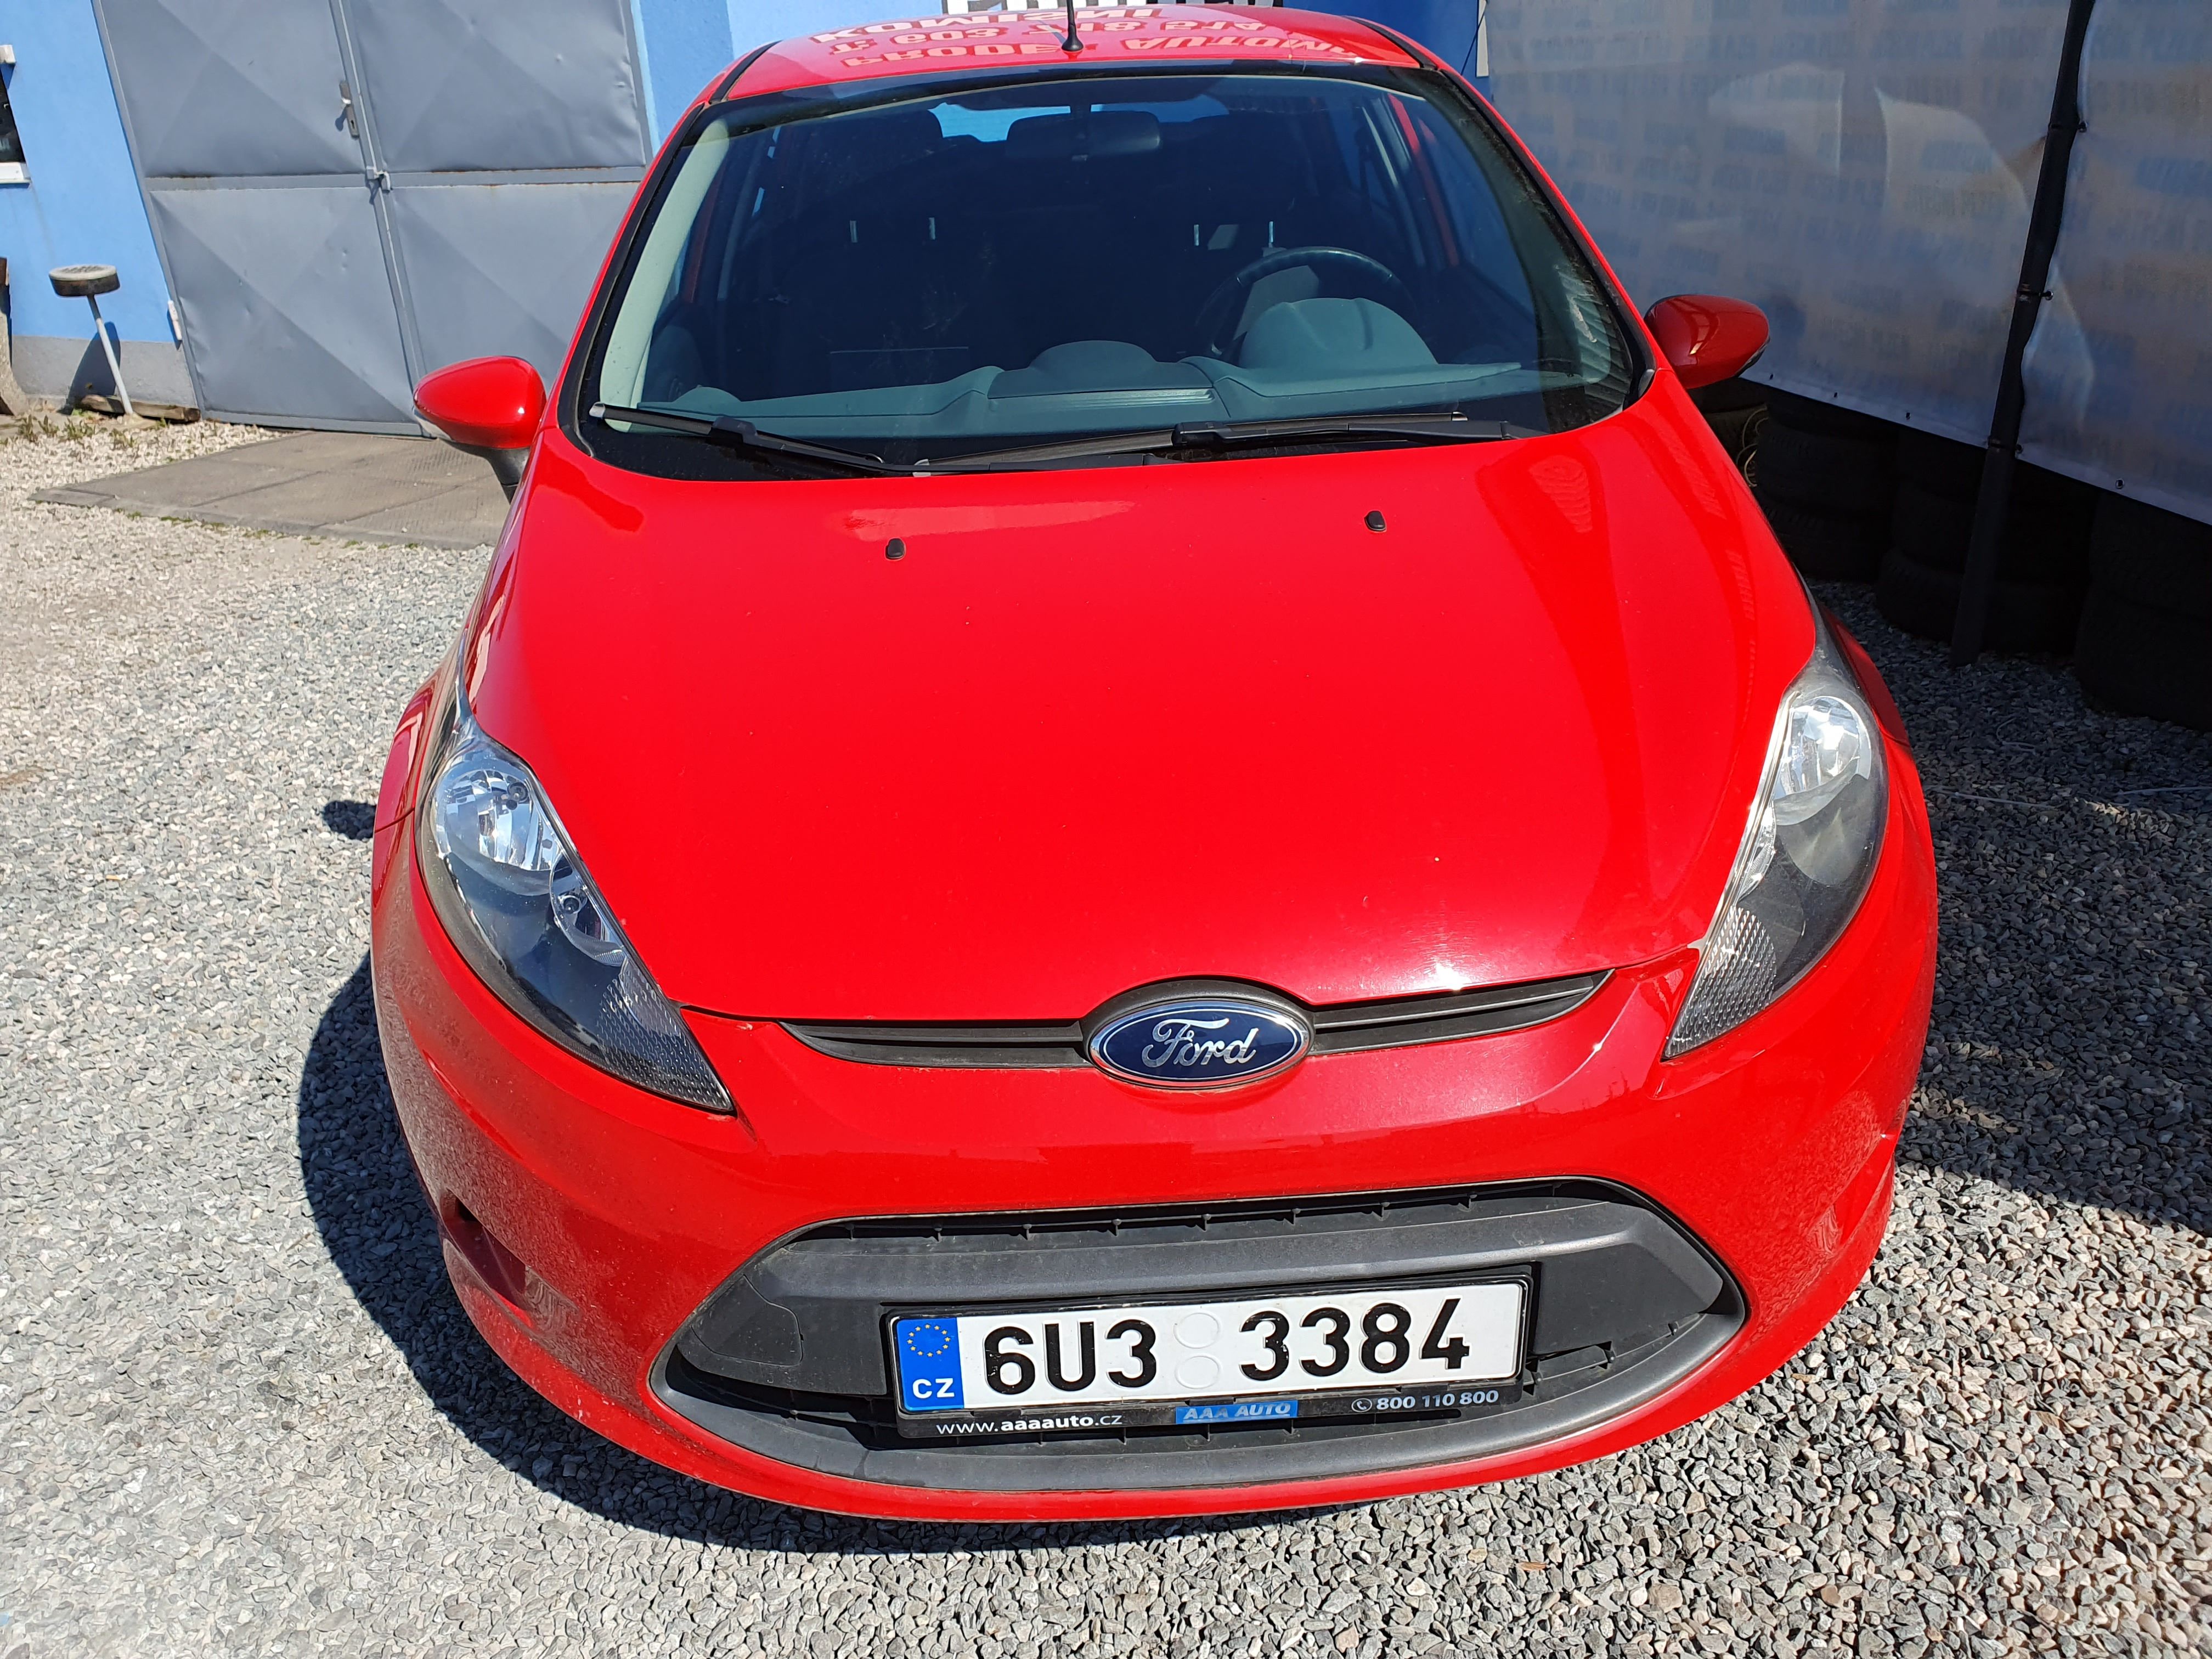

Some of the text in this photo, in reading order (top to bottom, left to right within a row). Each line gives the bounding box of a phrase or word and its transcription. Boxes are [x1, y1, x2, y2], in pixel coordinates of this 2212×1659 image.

[1141, 1018, 1259, 1068] Ford
[984, 1297, 1470, 1395] 6U3 3384
[912, 1378, 955, 1399] CZ
[1376, 1390, 1499, 1410] 800 110 800
[1183, 1402, 1291, 1420] AAA AUTO
[935, 1414, 1123, 1435] www.aaaauto.cz
